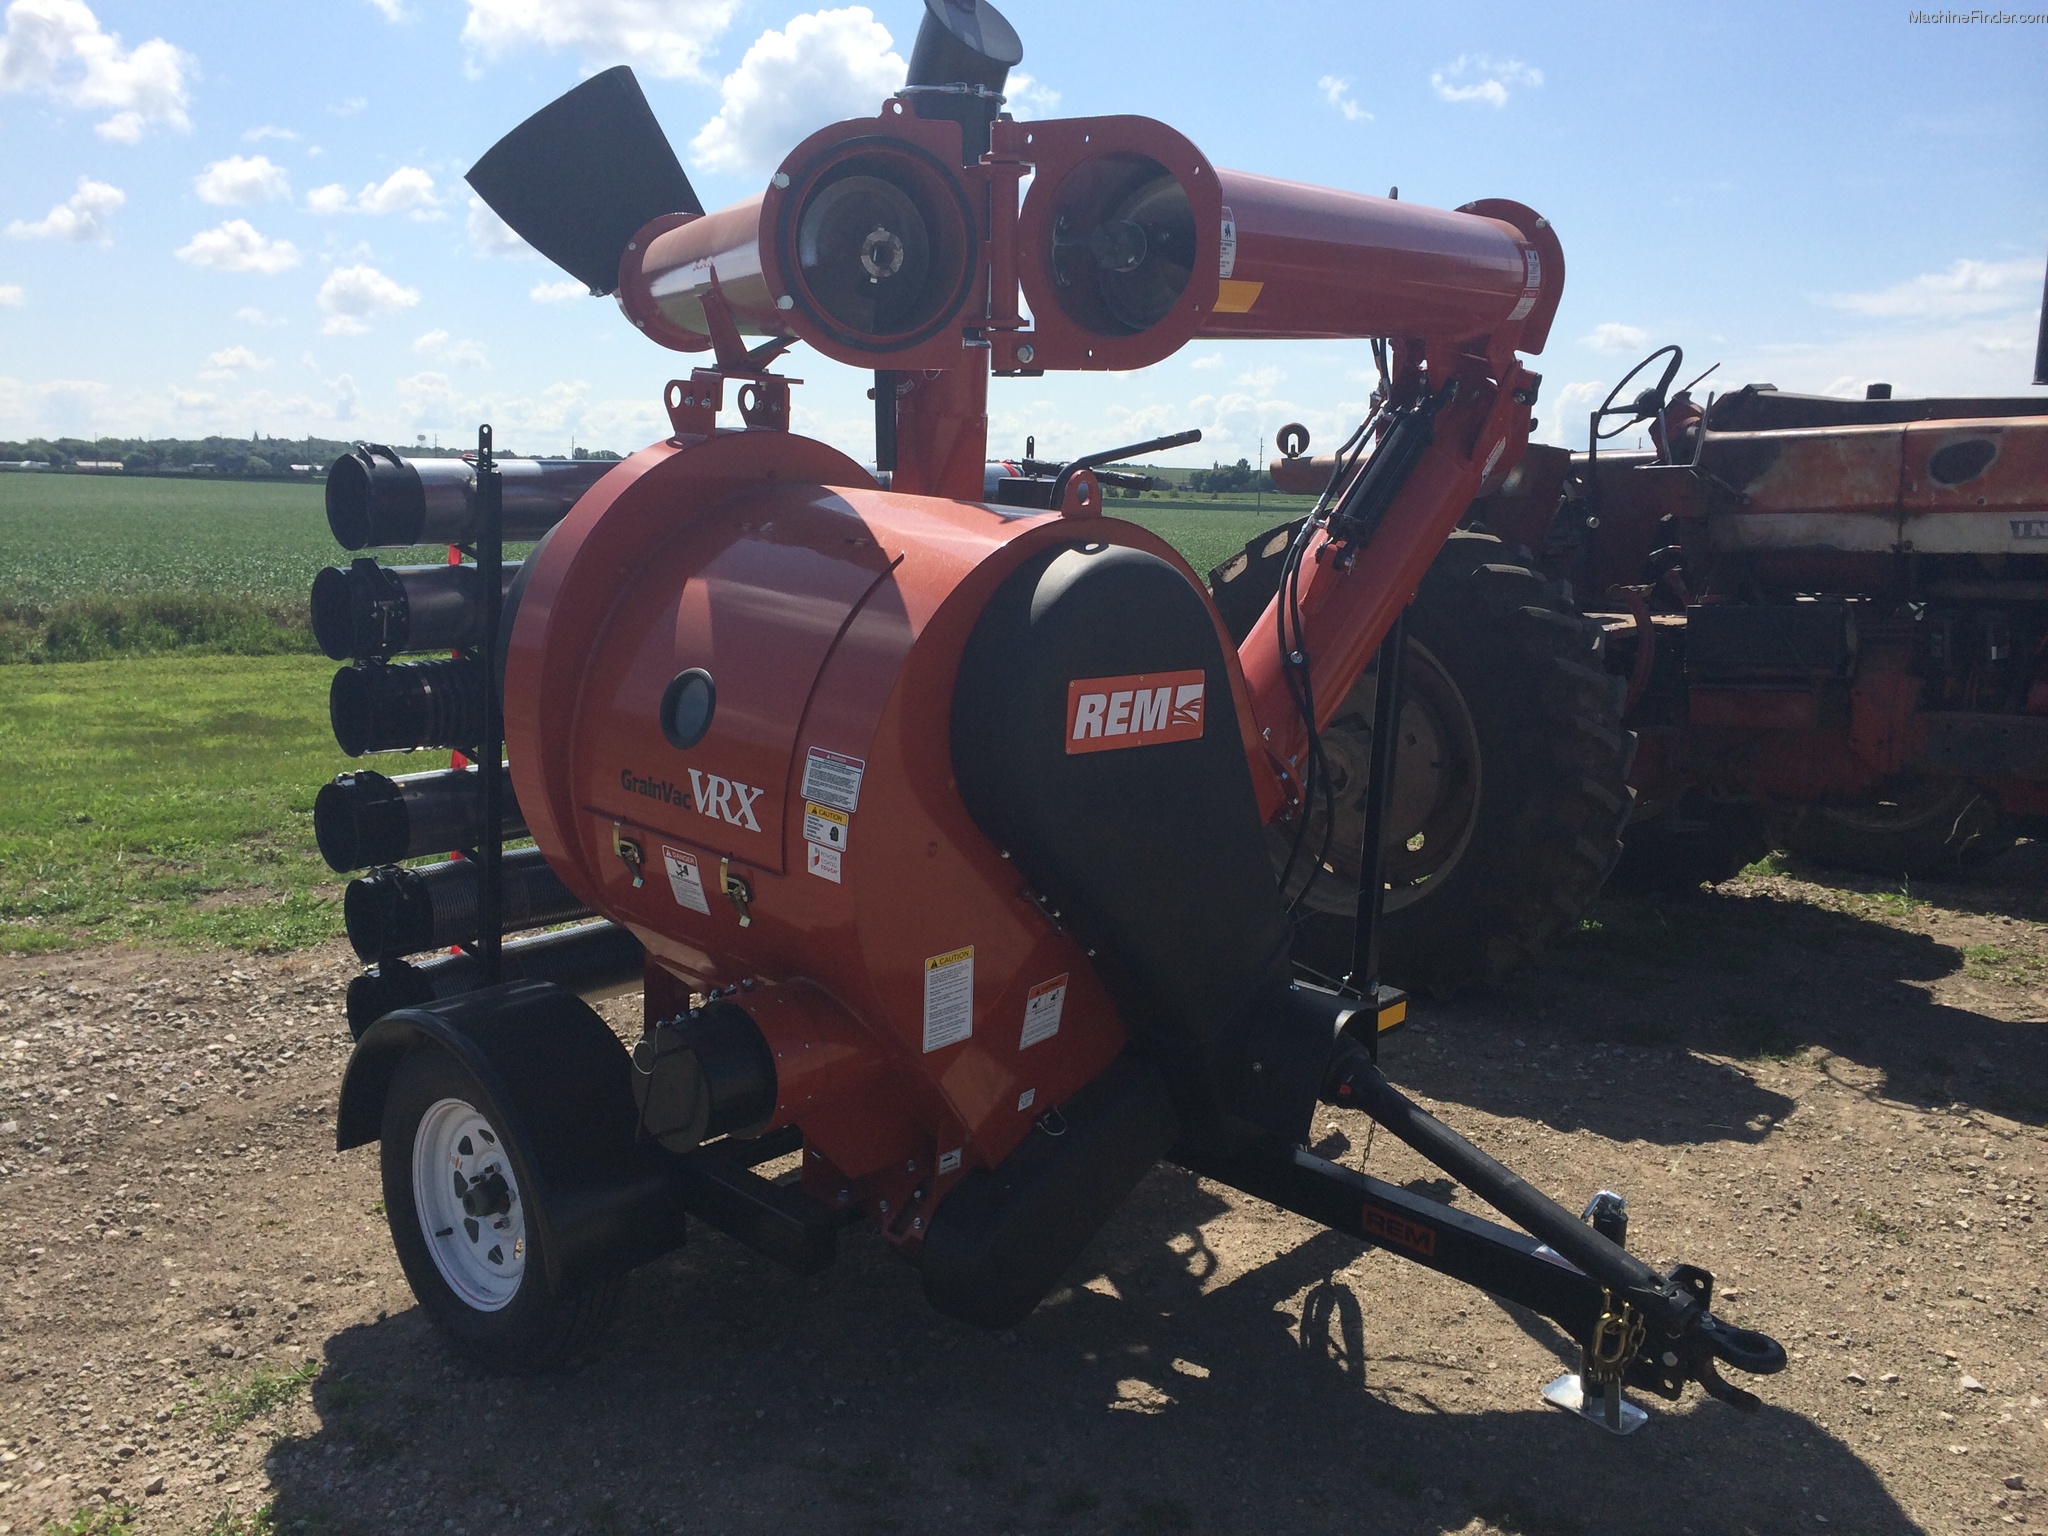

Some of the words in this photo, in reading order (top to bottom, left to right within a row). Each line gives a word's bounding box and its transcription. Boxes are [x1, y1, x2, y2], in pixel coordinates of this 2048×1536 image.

[1072, 686, 1172, 740] REM
[620, 768, 692, 811] GrainVac
[687, 768, 764, 833] VRX
[818, 808, 843, 822] CAUTION
[671, 851, 695, 864] DANGER
[939, 950, 970, 965] CAUTION
[1367, 1211, 1431, 1250] REM
